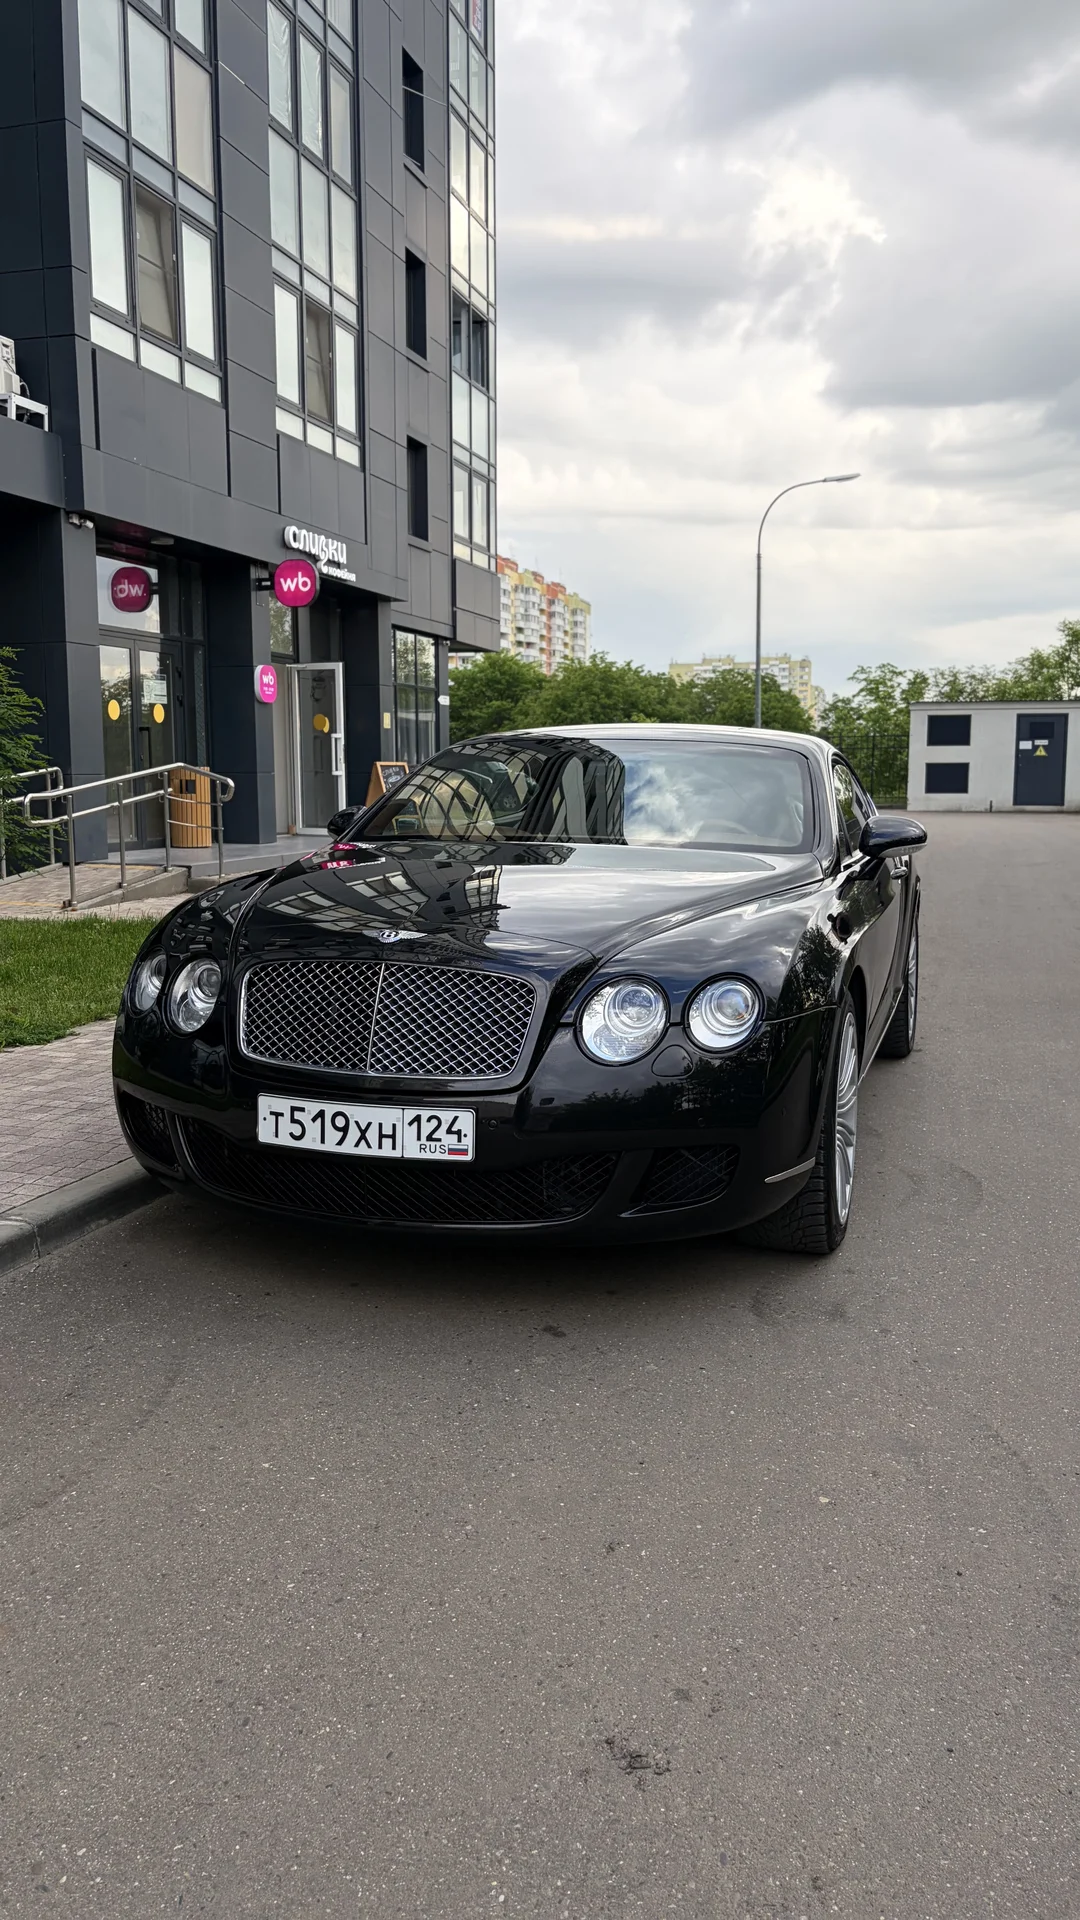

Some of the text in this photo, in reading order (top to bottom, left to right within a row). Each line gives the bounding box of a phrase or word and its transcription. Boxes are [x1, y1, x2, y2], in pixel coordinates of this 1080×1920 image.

[280, 571, 311, 592] wb
[262, 672, 275, 685] wb
[407, 1113, 463, 1143] 124
[419, 1144, 447, 1154] RUS
